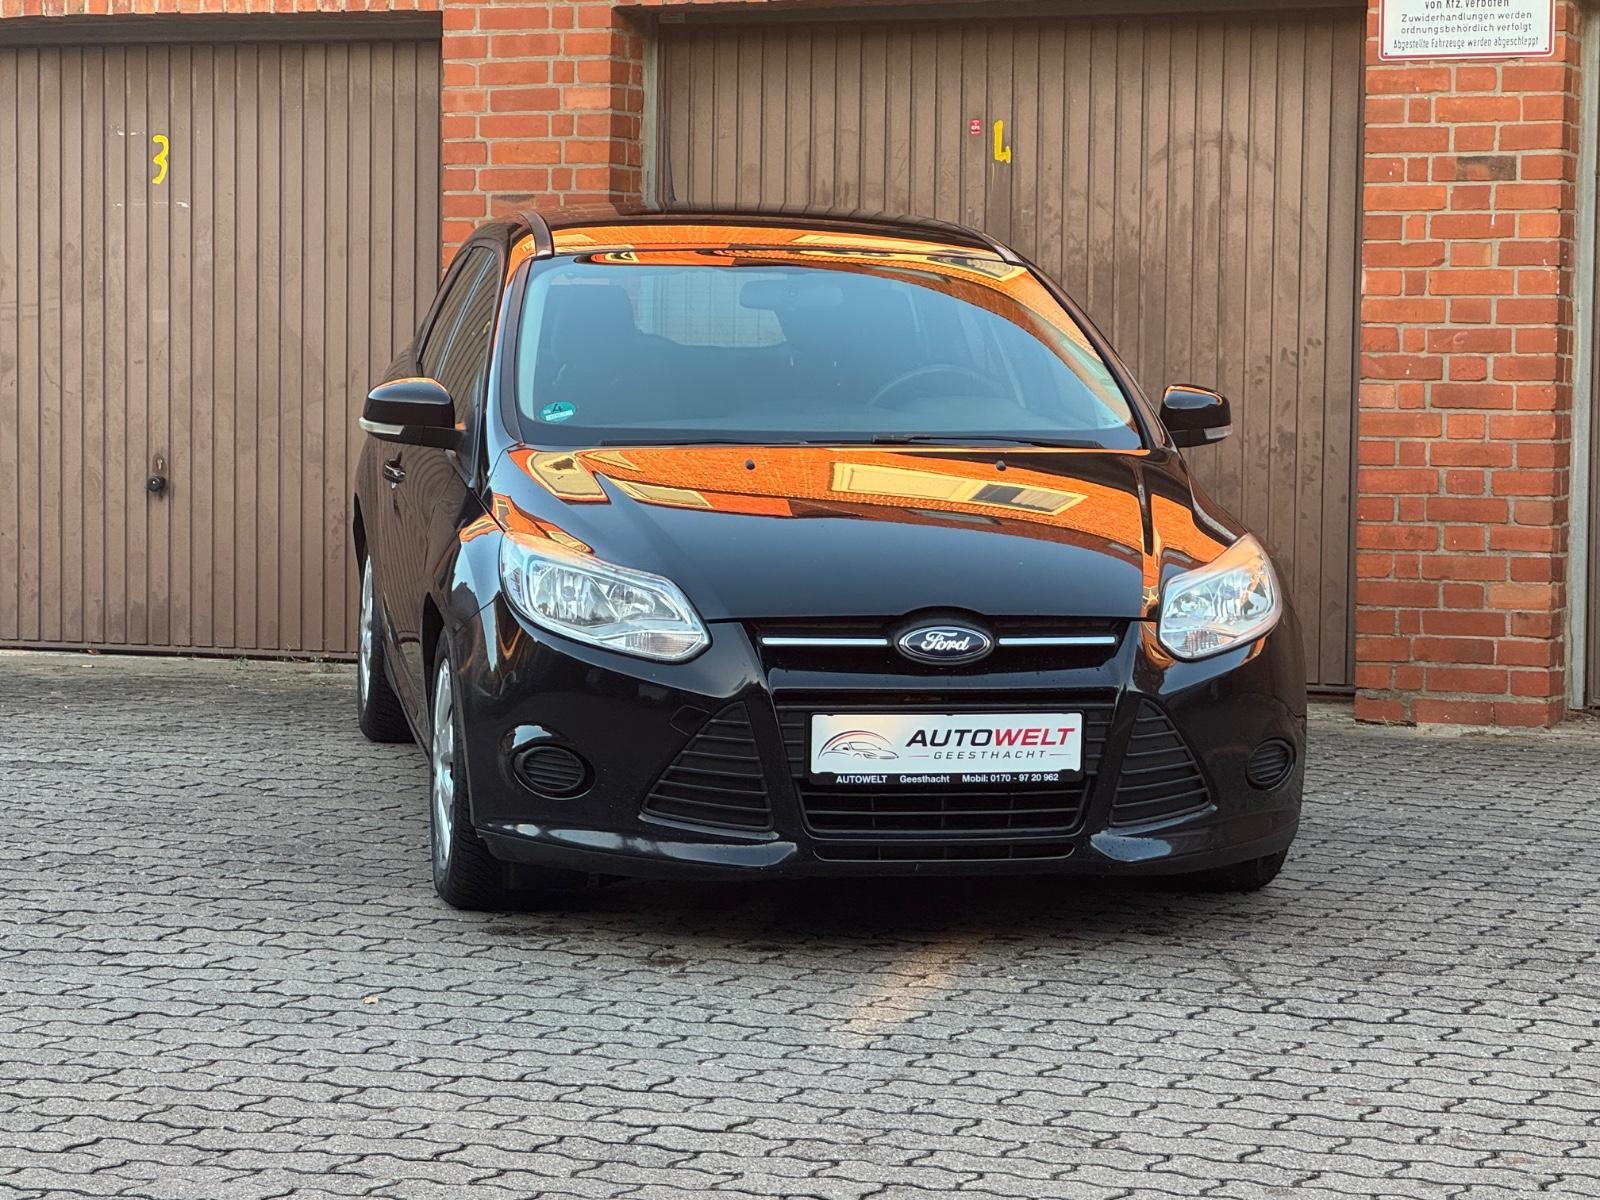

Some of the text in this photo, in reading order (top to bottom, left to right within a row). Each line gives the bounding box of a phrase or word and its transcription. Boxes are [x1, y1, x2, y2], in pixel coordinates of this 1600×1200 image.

[1425, 0, 1442, 9] von
[1401, 11, 1532, 23] Zuwiderhandlungen werden
[1400, 23, 1532, 35] ordnungsbehördlich verfolgt
[1393, 36, 1539, 51] Abgestellte Fahrzeuge werden abgeschleppt
[152, 134, 169, 185] 3
[921, 631, 971, 652] Ford
[905, 727, 1076, 748] AUTOWELT
[933, 750, 1047, 760] GEESTHACHT
[835, 775, 888, 784] AUTOWELT
[899, 774, 951, 784] Geesthacht
[961, 774, 989, 783] Mobil:
[990, 774, 1011, 783] 0170
[1018, 773, 1029, 782] 97
[1030, 773, 1042, 782] 20
[1043, 773, 1059, 782] 962
